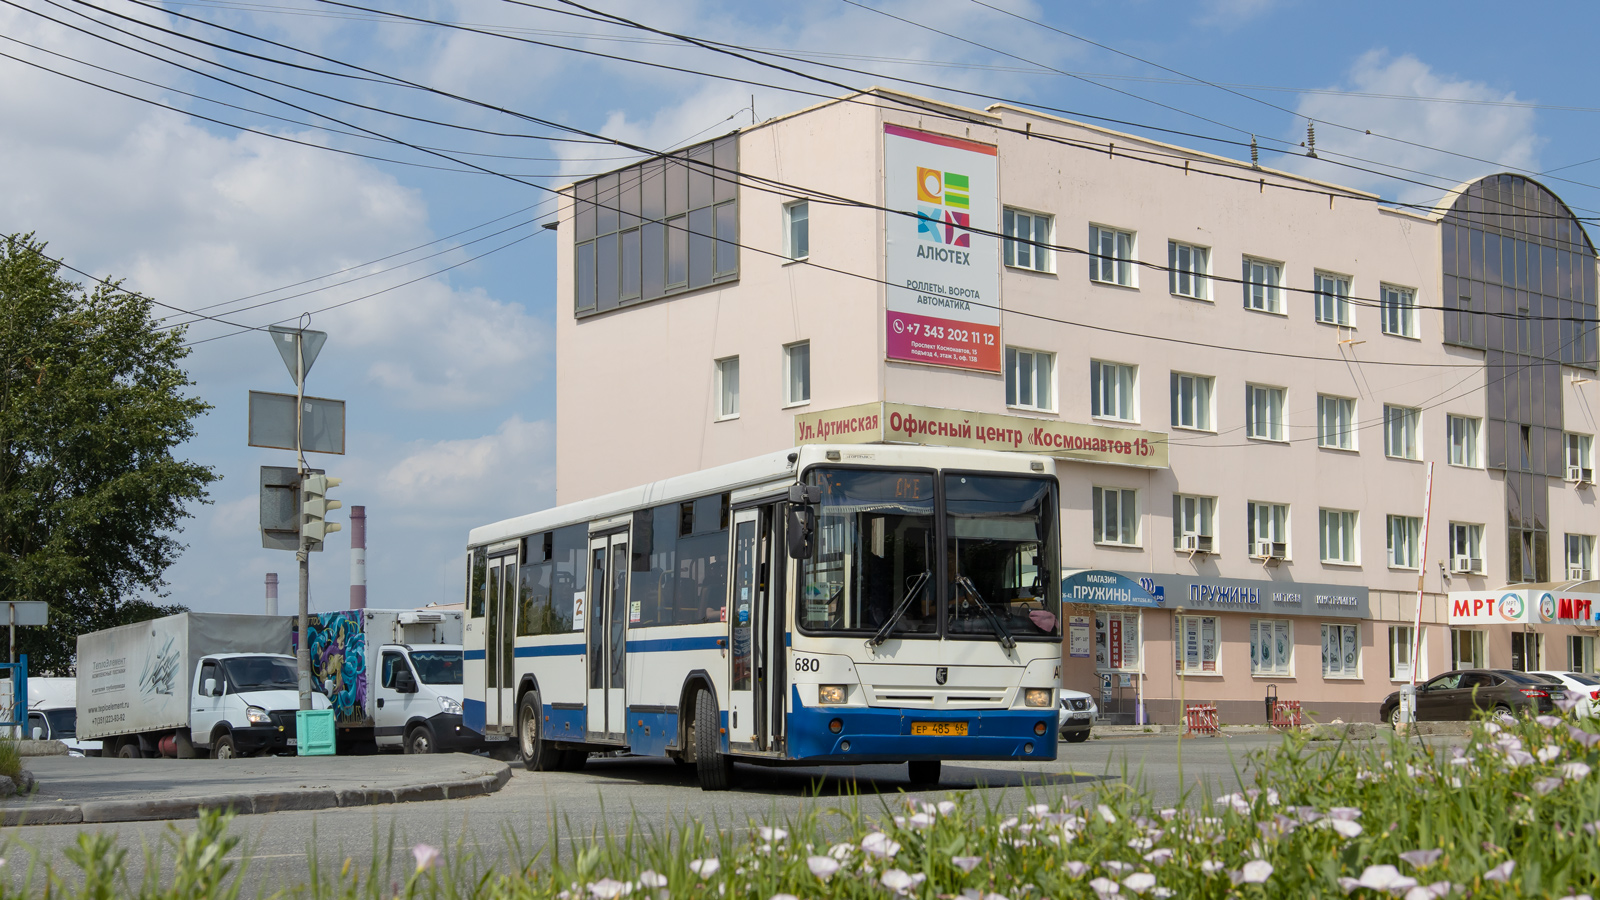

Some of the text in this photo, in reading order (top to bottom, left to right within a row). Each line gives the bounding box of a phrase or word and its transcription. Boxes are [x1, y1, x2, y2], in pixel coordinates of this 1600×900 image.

[917, 244, 970, 266] АЛЮТЕХ
[906, 280, 980, 299] РОЛЛЕТЫ. ВОРОТА
[917, 295, 970, 311] АВТОМАТИКА
[907, 323, 994, 345] +7 343 202 11 12
[911, 341, 935, 349] Проспект
[937, 345, 971, 355] Космонавтов,
[799, 415, 878, 441] Ул. Артинская
[890, 412, 971, 438] Офисный
[976, 426, 1022, 448] центр
[1087, 575, 1116, 584] МАГАЗИН
[1073, 586, 1131, 602] ПРУЖИНЫ
[1189, 584, 1260, 604] ПРУЖИНЫ
[576, 599, 582, 616] 2
[1453, 599, 1495, 617] МРТ
[1558, 599, 1592, 620] МРТ
[93, 658, 126, 670] ТеплоЭлемент
[794, 658, 820, 672] 680
[933, 724, 950, 734] 485
